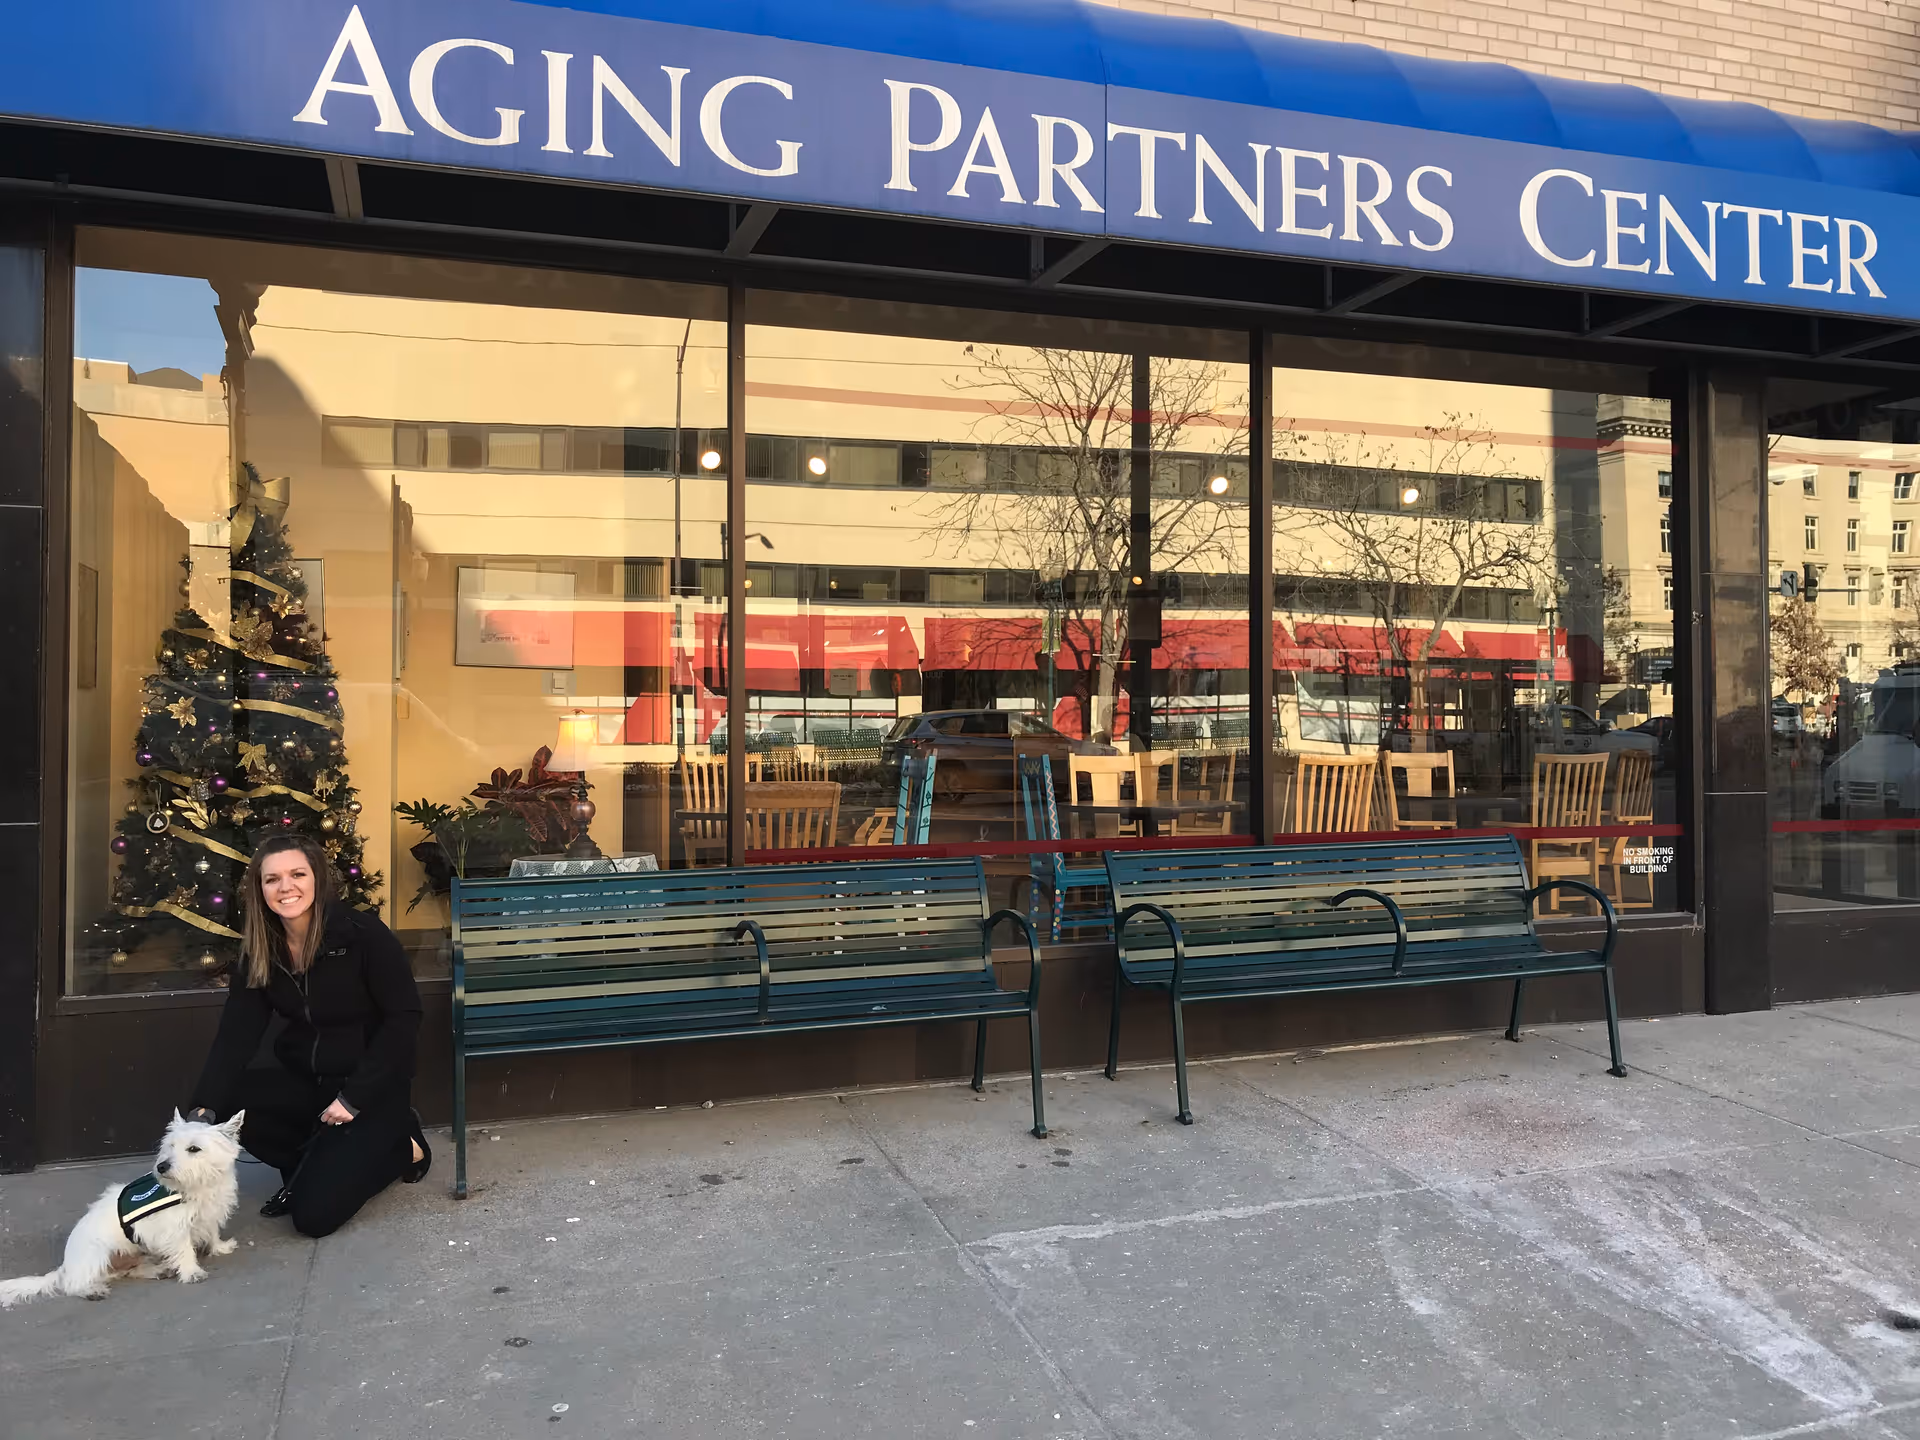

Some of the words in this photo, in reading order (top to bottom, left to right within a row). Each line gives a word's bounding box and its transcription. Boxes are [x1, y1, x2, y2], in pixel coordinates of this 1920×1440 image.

[293, 4, 803, 178] AGING
[883, 78, 1455, 253] PARTNERS
[1519, 168, 1887, 299] CENTER
[1623, 848, 1635, 856] NO
[1636, 847, 1674, 856] SMOKING
[1623, 857, 1632, 865] IN
[1633, 856, 1660, 864] FRONT
[1662, 856, 1674, 864] OF
[1630, 864, 1668, 874] BUILDING
